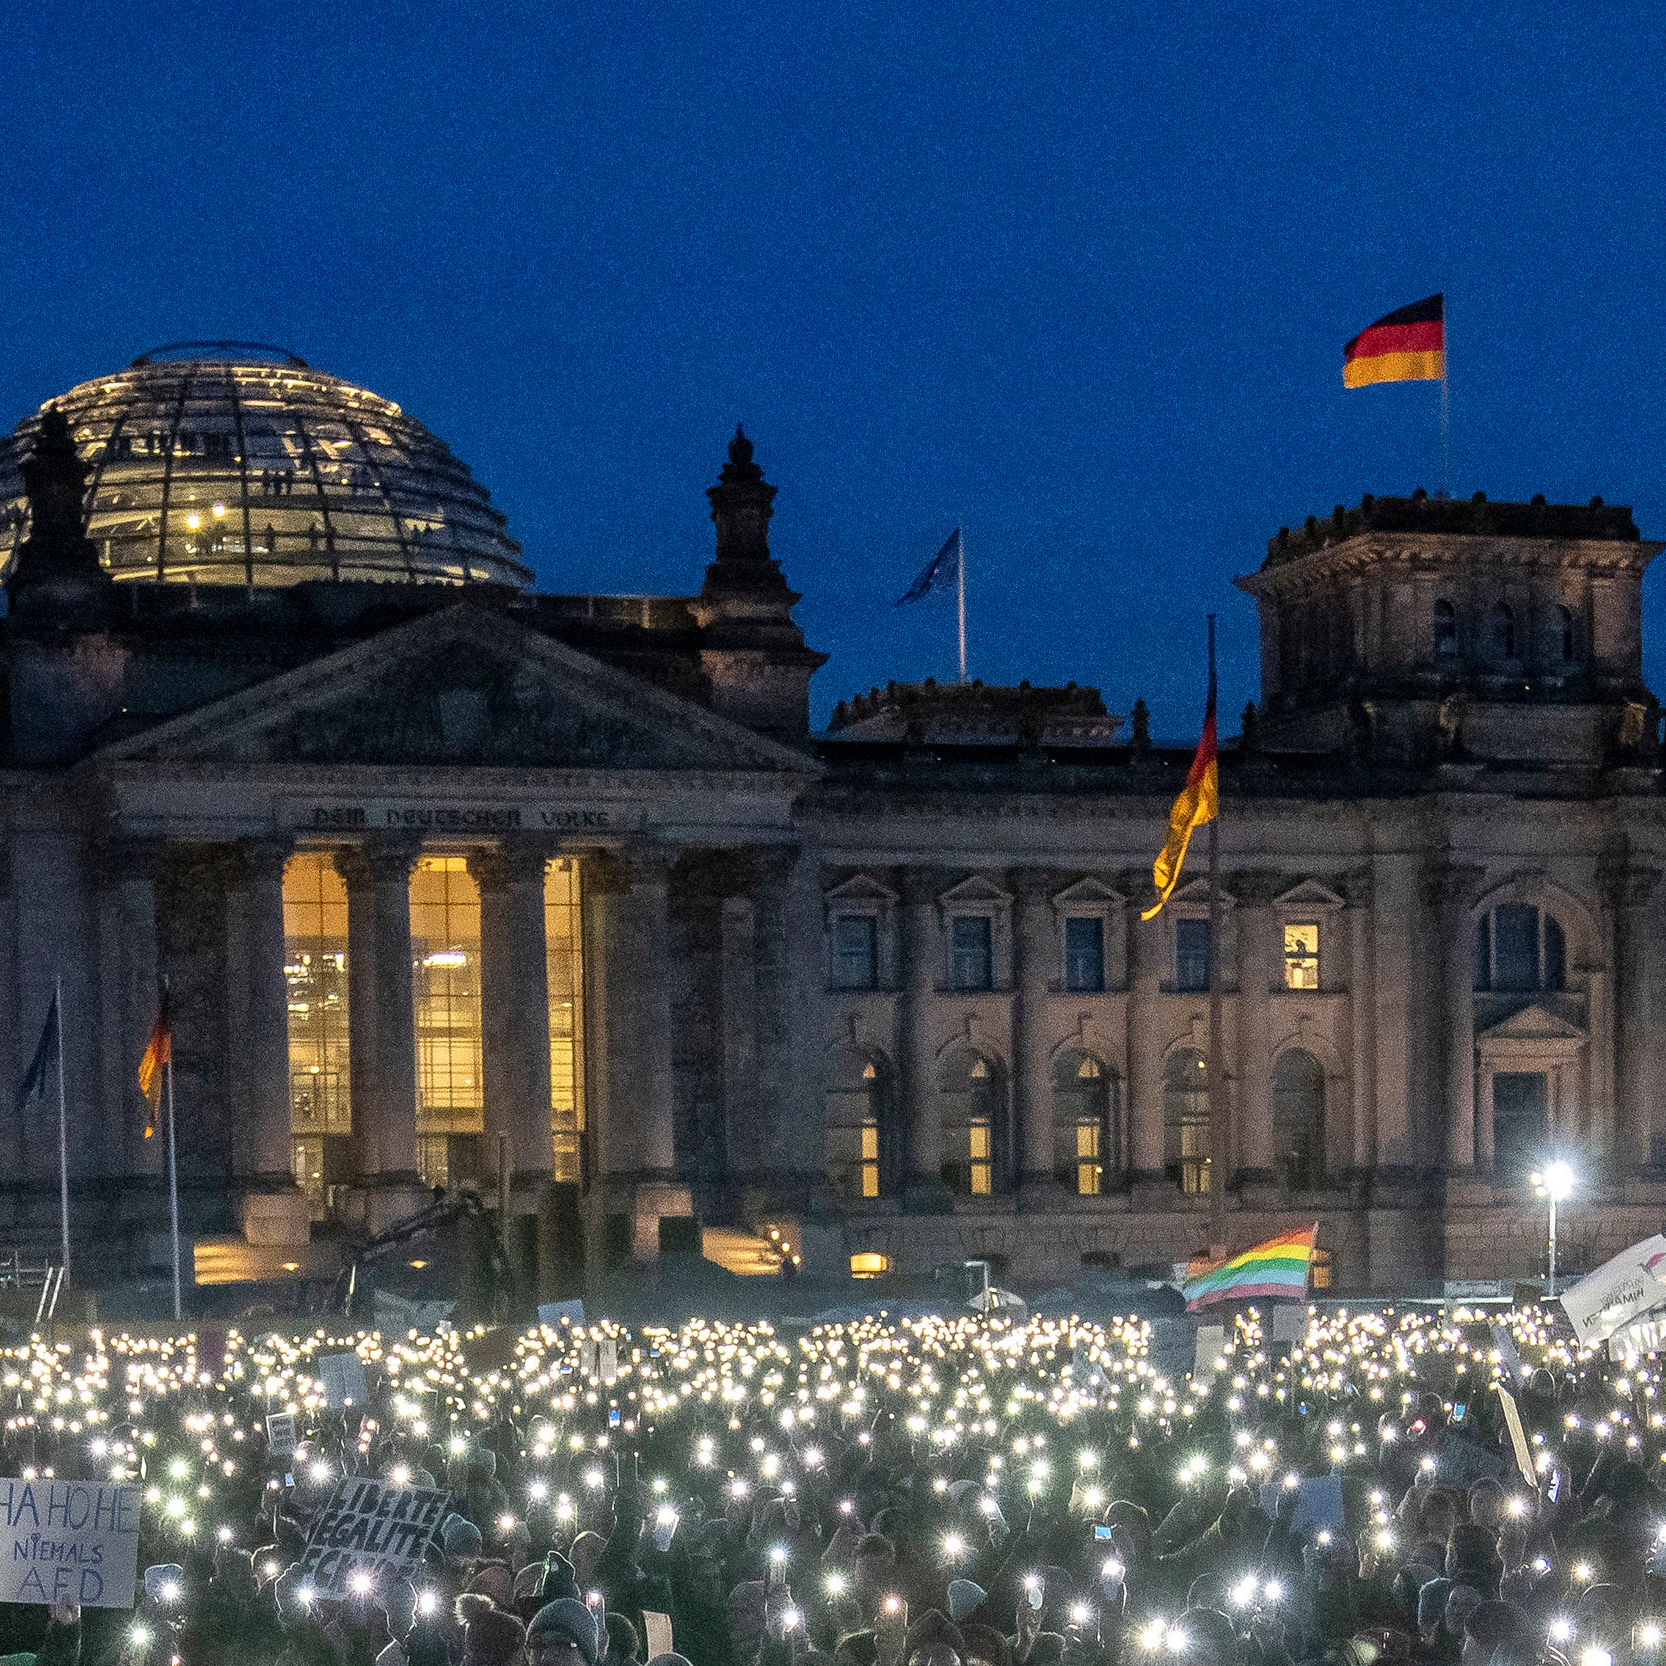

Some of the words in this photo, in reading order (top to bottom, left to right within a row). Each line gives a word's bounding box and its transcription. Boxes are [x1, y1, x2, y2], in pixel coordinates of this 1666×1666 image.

[314, 808, 365, 825] DEM
[387, 808, 521, 826] DEUTSCHEN
[541, 809, 610, 827] VOLKE
[14, 1532, 104, 1564] NIEMALS
[17, 1566, 104, 1603] AFD
